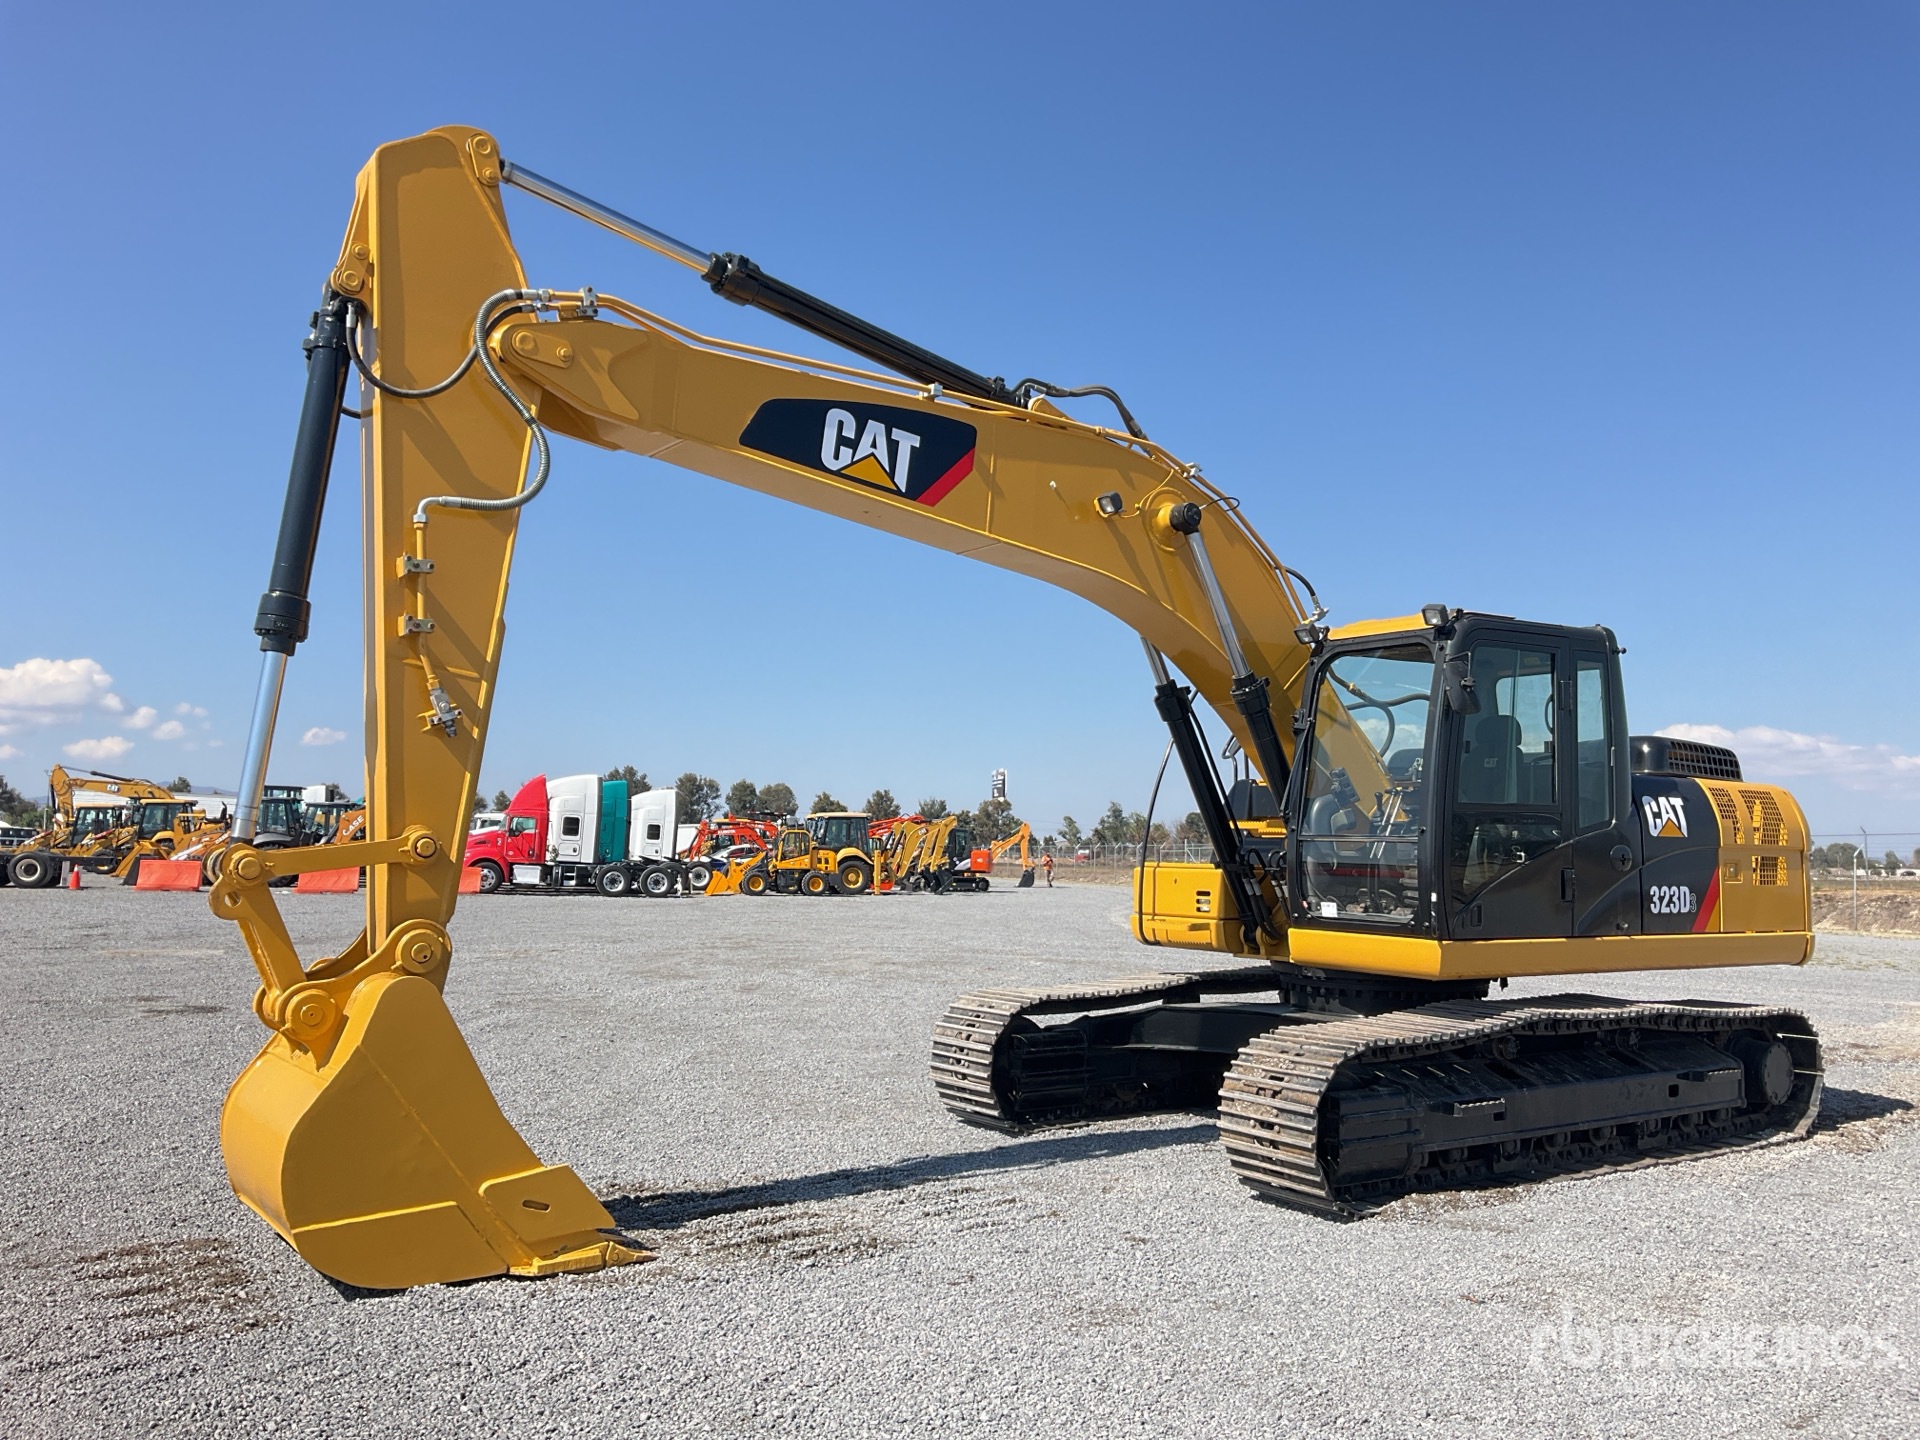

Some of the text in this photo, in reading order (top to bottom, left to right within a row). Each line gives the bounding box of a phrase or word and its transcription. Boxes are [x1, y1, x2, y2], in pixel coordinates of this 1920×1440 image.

[821, 407, 920, 493] CAT
[107, 784, 119, 792] CAT
[343, 815, 364, 836] CASE
[1642, 796, 1688, 837] CAT
